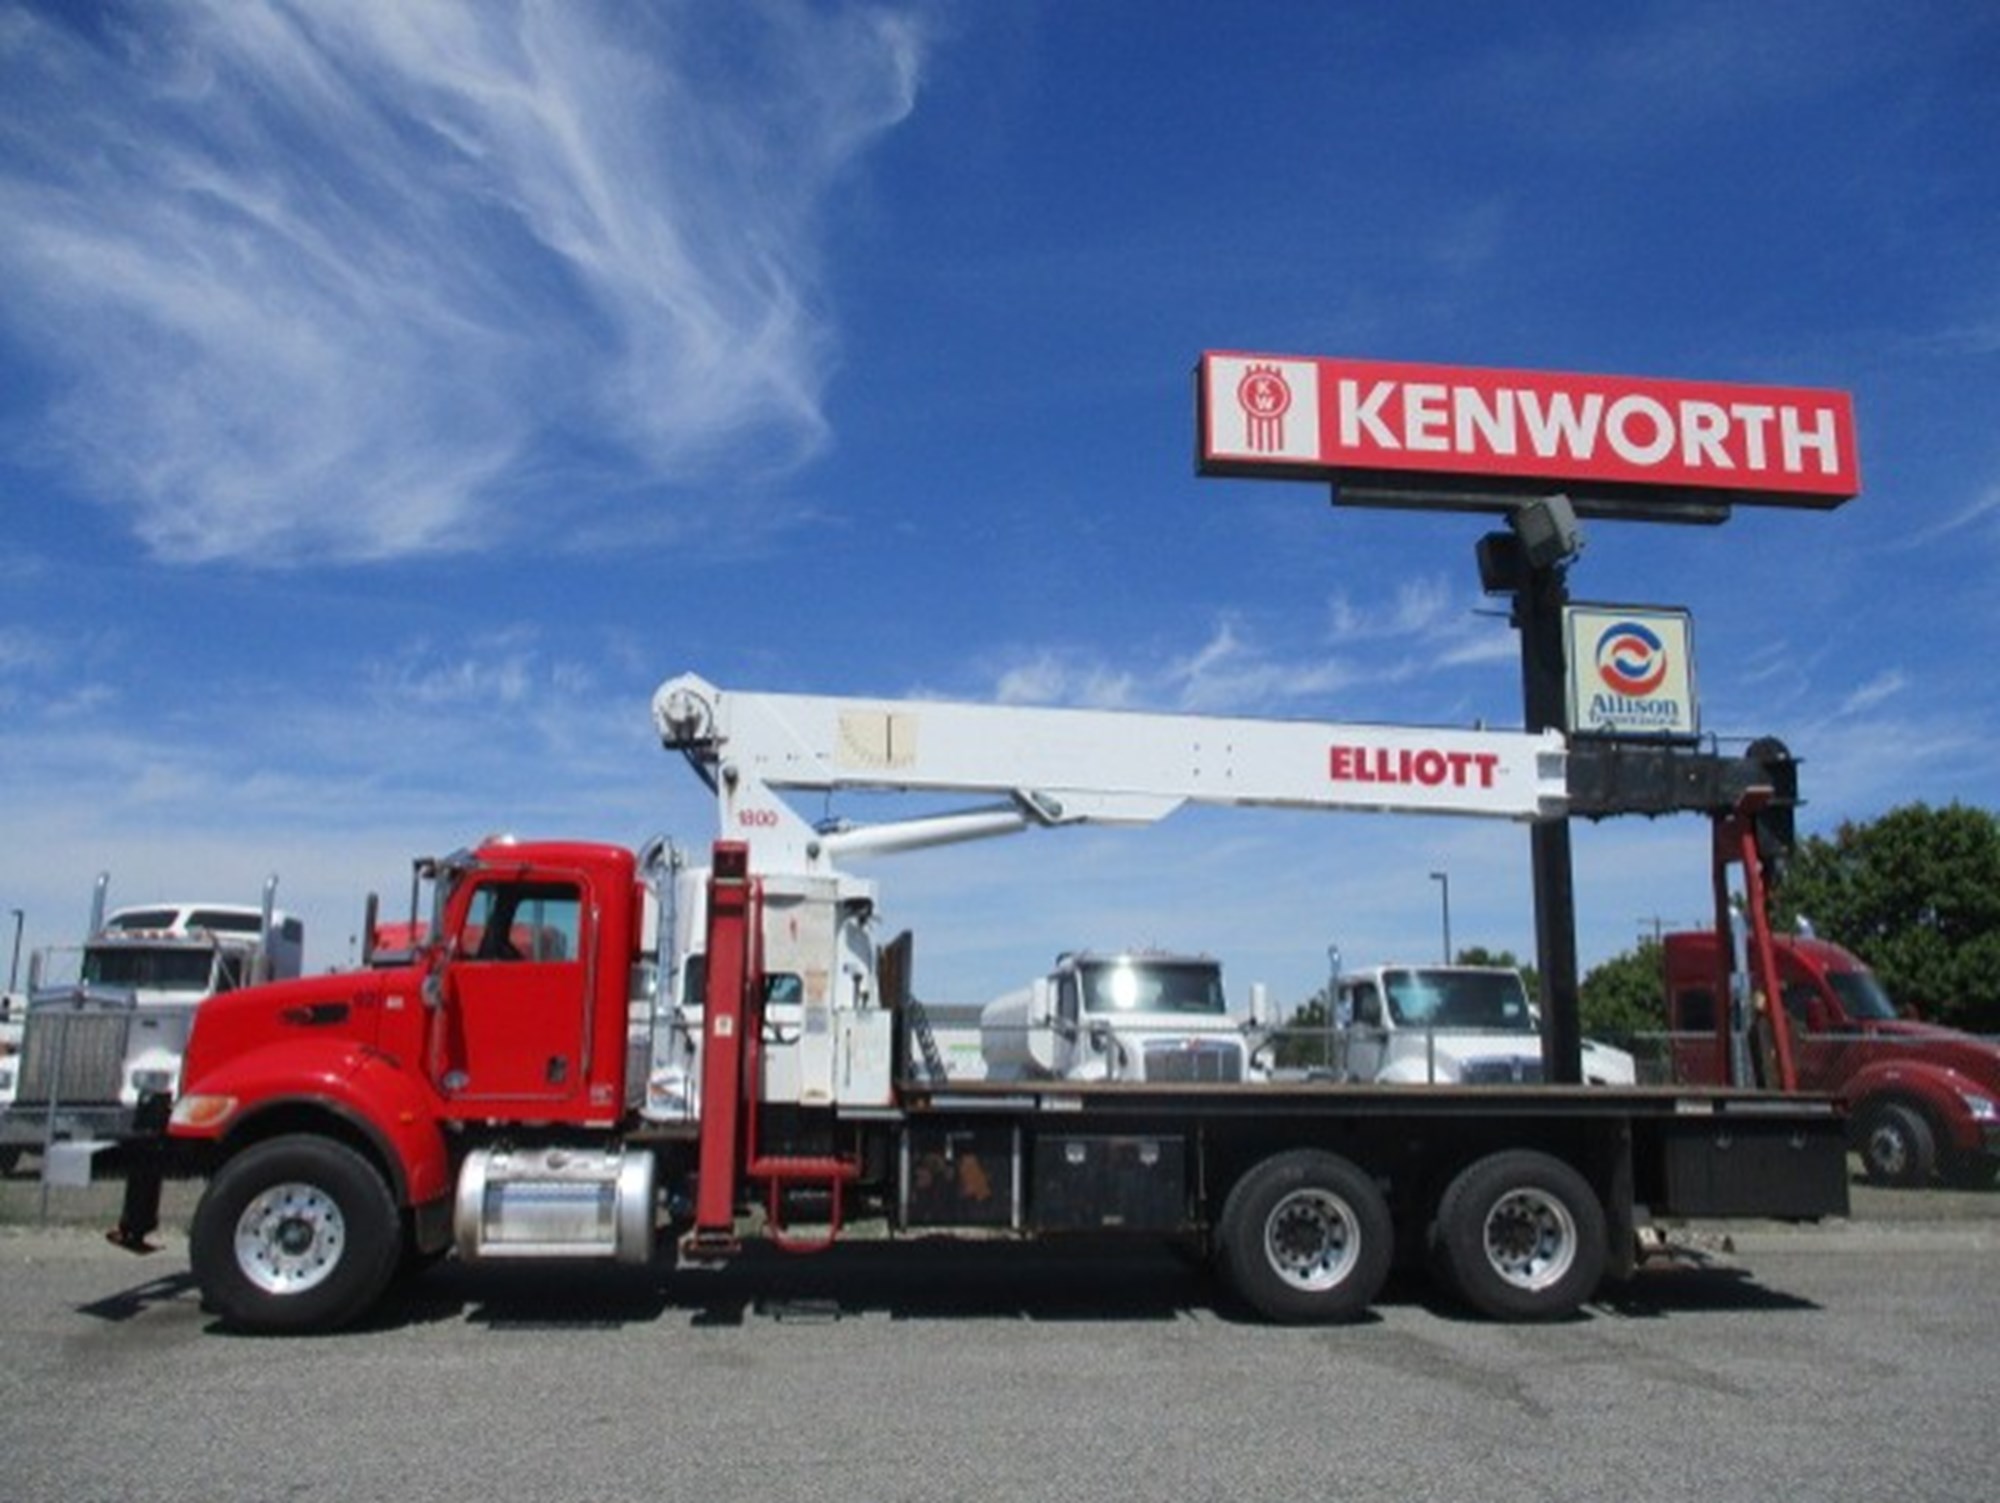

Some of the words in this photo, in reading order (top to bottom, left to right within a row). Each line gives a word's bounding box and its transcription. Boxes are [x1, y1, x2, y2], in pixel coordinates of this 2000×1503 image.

[1338, 378, 1839, 475] KENWORTH
[1589, 692, 1679, 716] Allison
[1330, 745, 1498, 788] ELLIOTT
